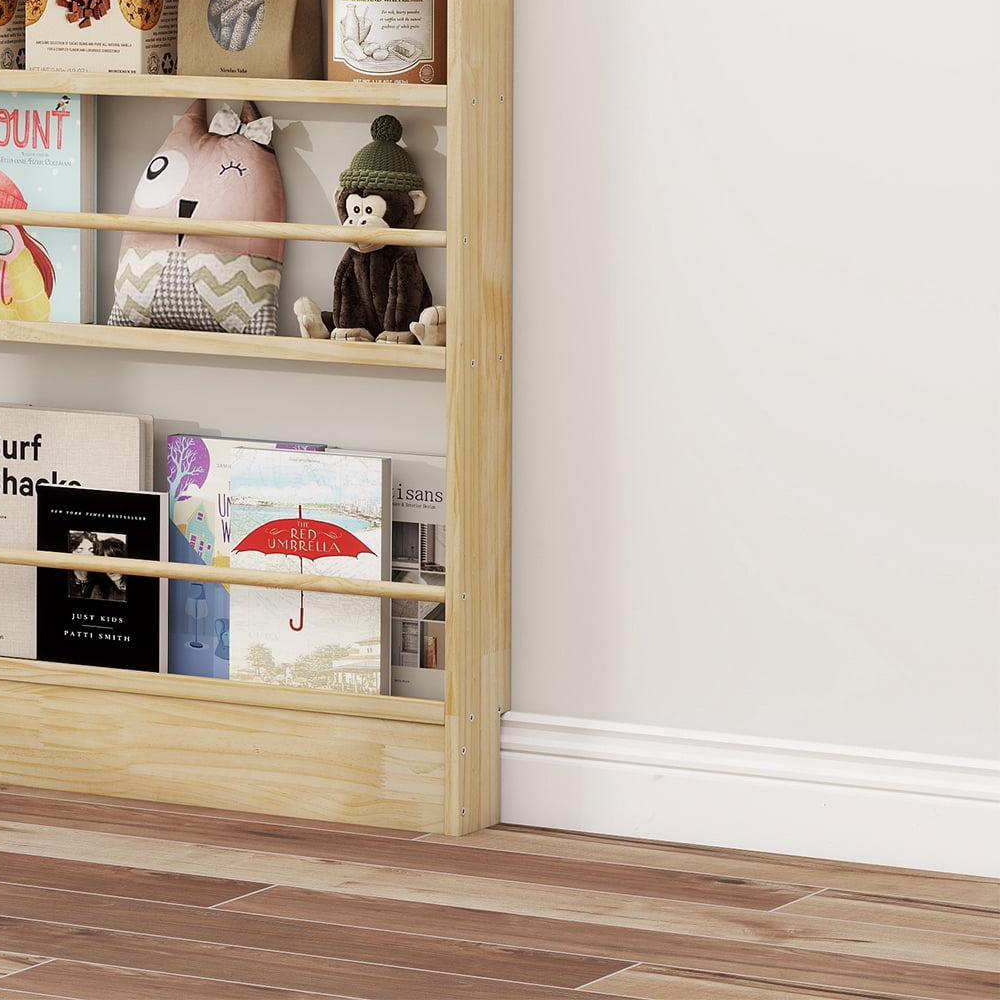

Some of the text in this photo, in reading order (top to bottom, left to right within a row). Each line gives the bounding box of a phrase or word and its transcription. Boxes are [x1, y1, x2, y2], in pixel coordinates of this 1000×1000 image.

[107, 513, 147, 521] BESTSELLER
[290, 528, 317, 541] RED
[267, 538, 341, 553] UMBRELLA
[72, 612, 124, 624] JUST KIDS
[63, 629, 131, 643] PATTI SMITH
